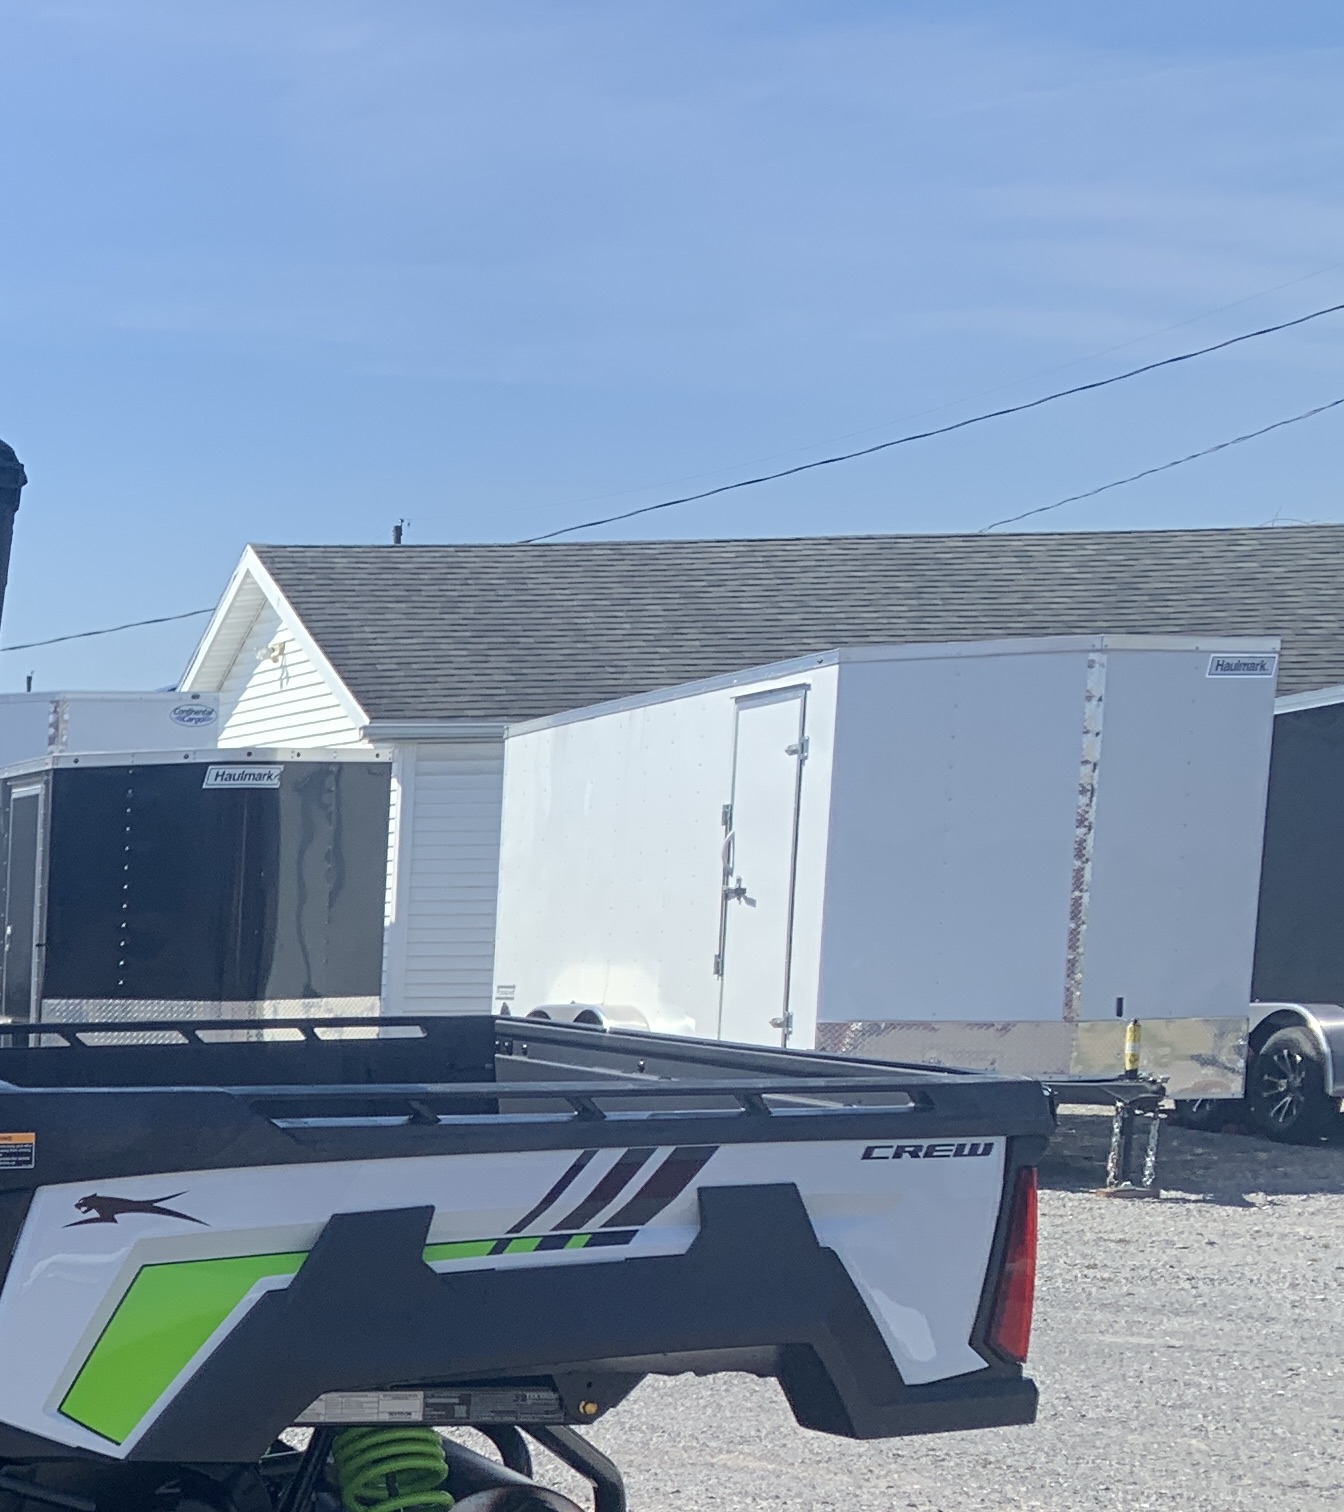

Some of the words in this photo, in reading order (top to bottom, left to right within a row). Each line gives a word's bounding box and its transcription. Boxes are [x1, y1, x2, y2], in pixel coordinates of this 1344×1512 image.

[1215, 659, 1267, 671] Haulmark
[173, 707, 215, 716] Continental
[214, 770, 273, 782] Haulmark
[861, 1142, 994, 1161] CREW
